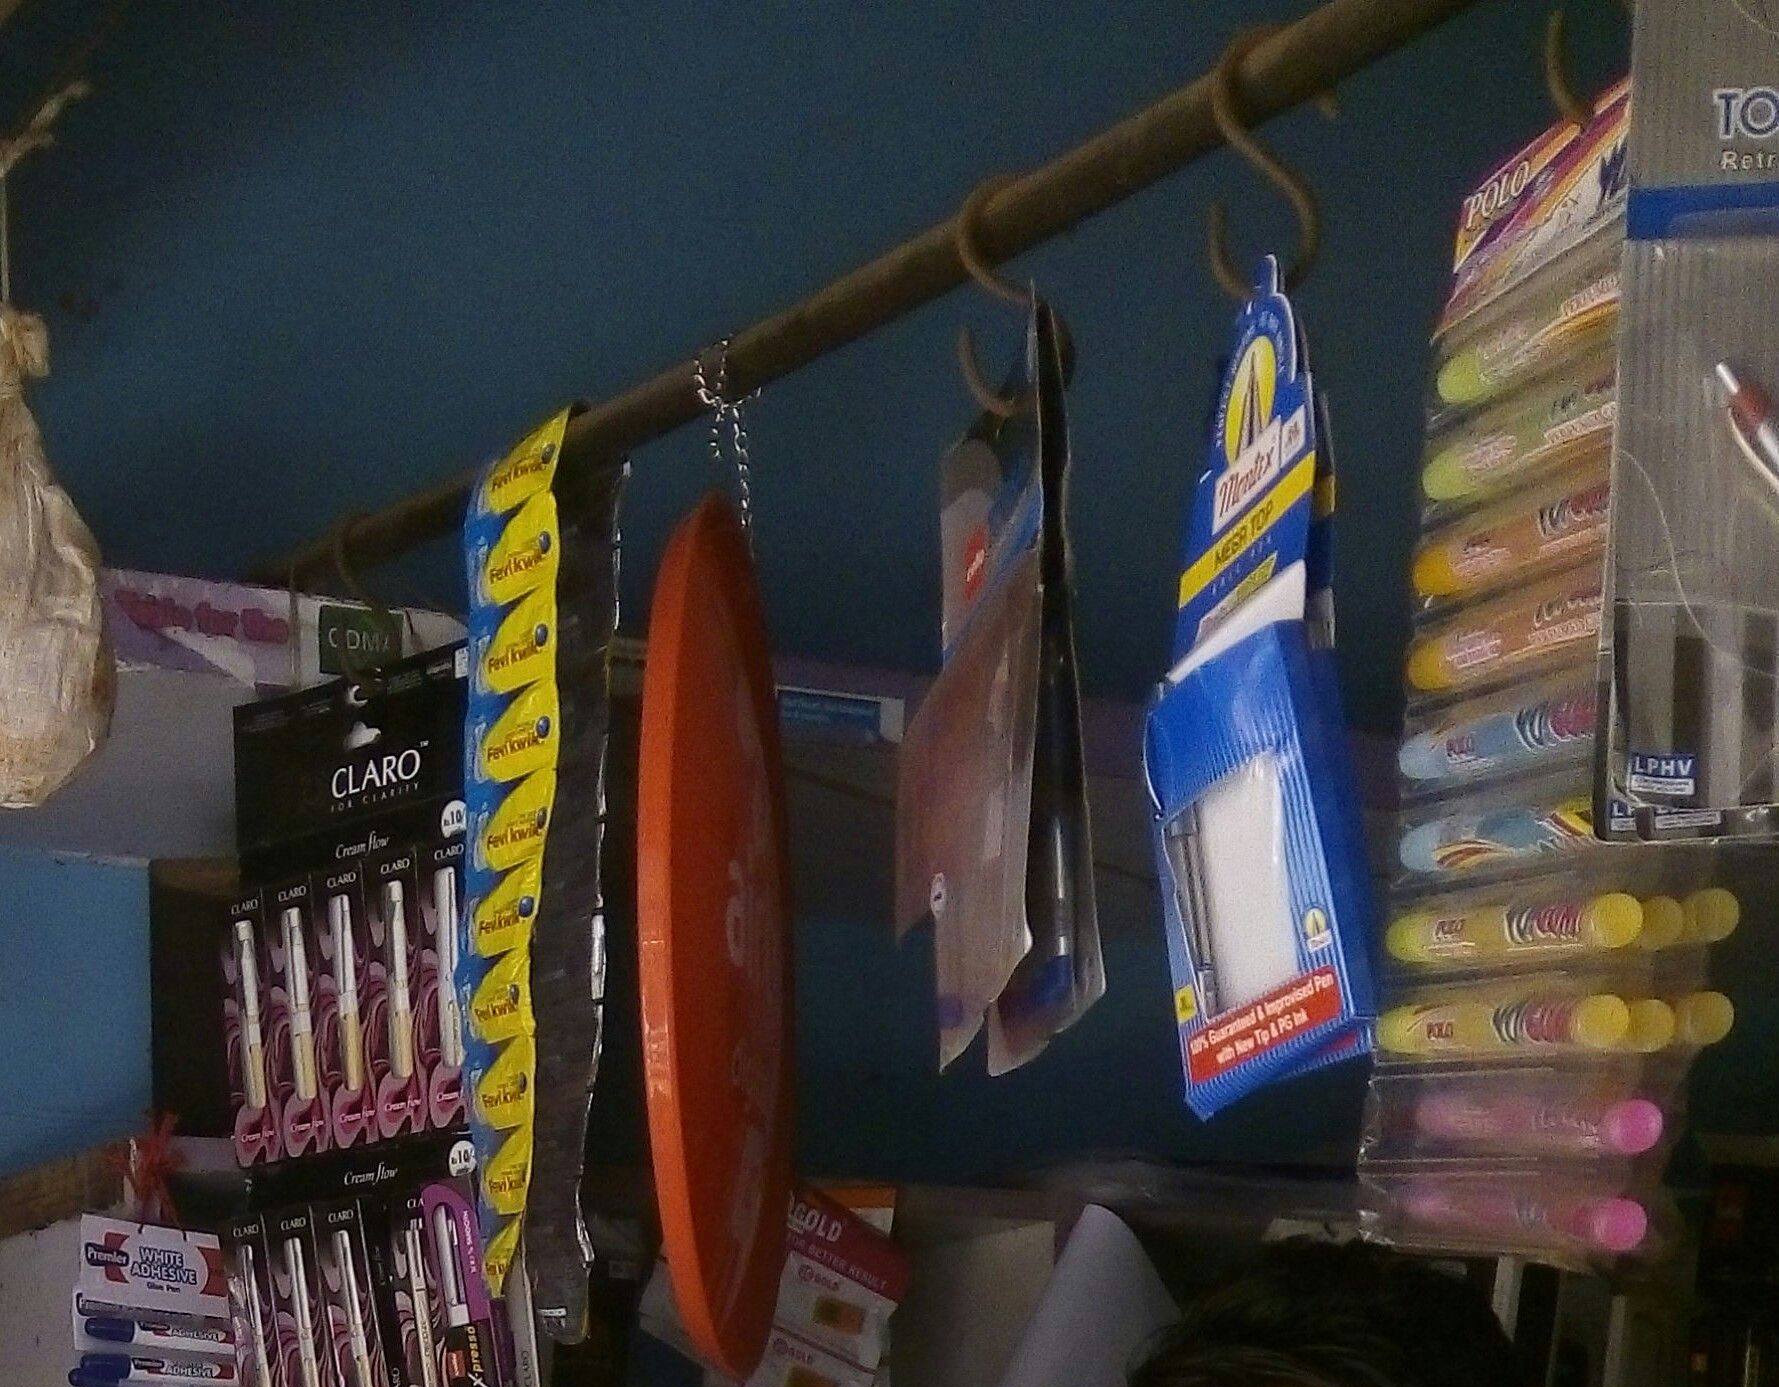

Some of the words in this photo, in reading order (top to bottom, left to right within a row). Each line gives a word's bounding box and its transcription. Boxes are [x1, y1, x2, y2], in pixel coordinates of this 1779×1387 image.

[1463, 161, 1531, 228] POLO
[331, 749, 422, 799] CLARO
[1635, 755, 1694, 777] LPHV
[361, 781, 420, 804] CLARITY
[335, 840, 367, 860] Cream
[366, 829, 391, 857] flow
[381, 857, 410, 874] CLARO
[327, 872, 357, 889] CLARO
[277, 885, 307, 902] CLARO
[231, 898, 259, 915] CLARO
[1208, 1012, 1258, 1044] Guaranteed
[1314, 971, 1335, 994] Pen
[343, 1170, 375, 1187] Cream
[373, 1161, 399, 1186] flow
[280, 1216, 307, 1231] CLARO
[327, 1208, 355, 1224] CLARO
[232, 1223, 260, 1239] CLARO
[86, 1243, 128, 1266] Premier
[139, 1246, 184, 1268] WHITE
[130, 1262, 197, 1286] ADHESIVE
[166, 1284, 181, 1294] Pen
